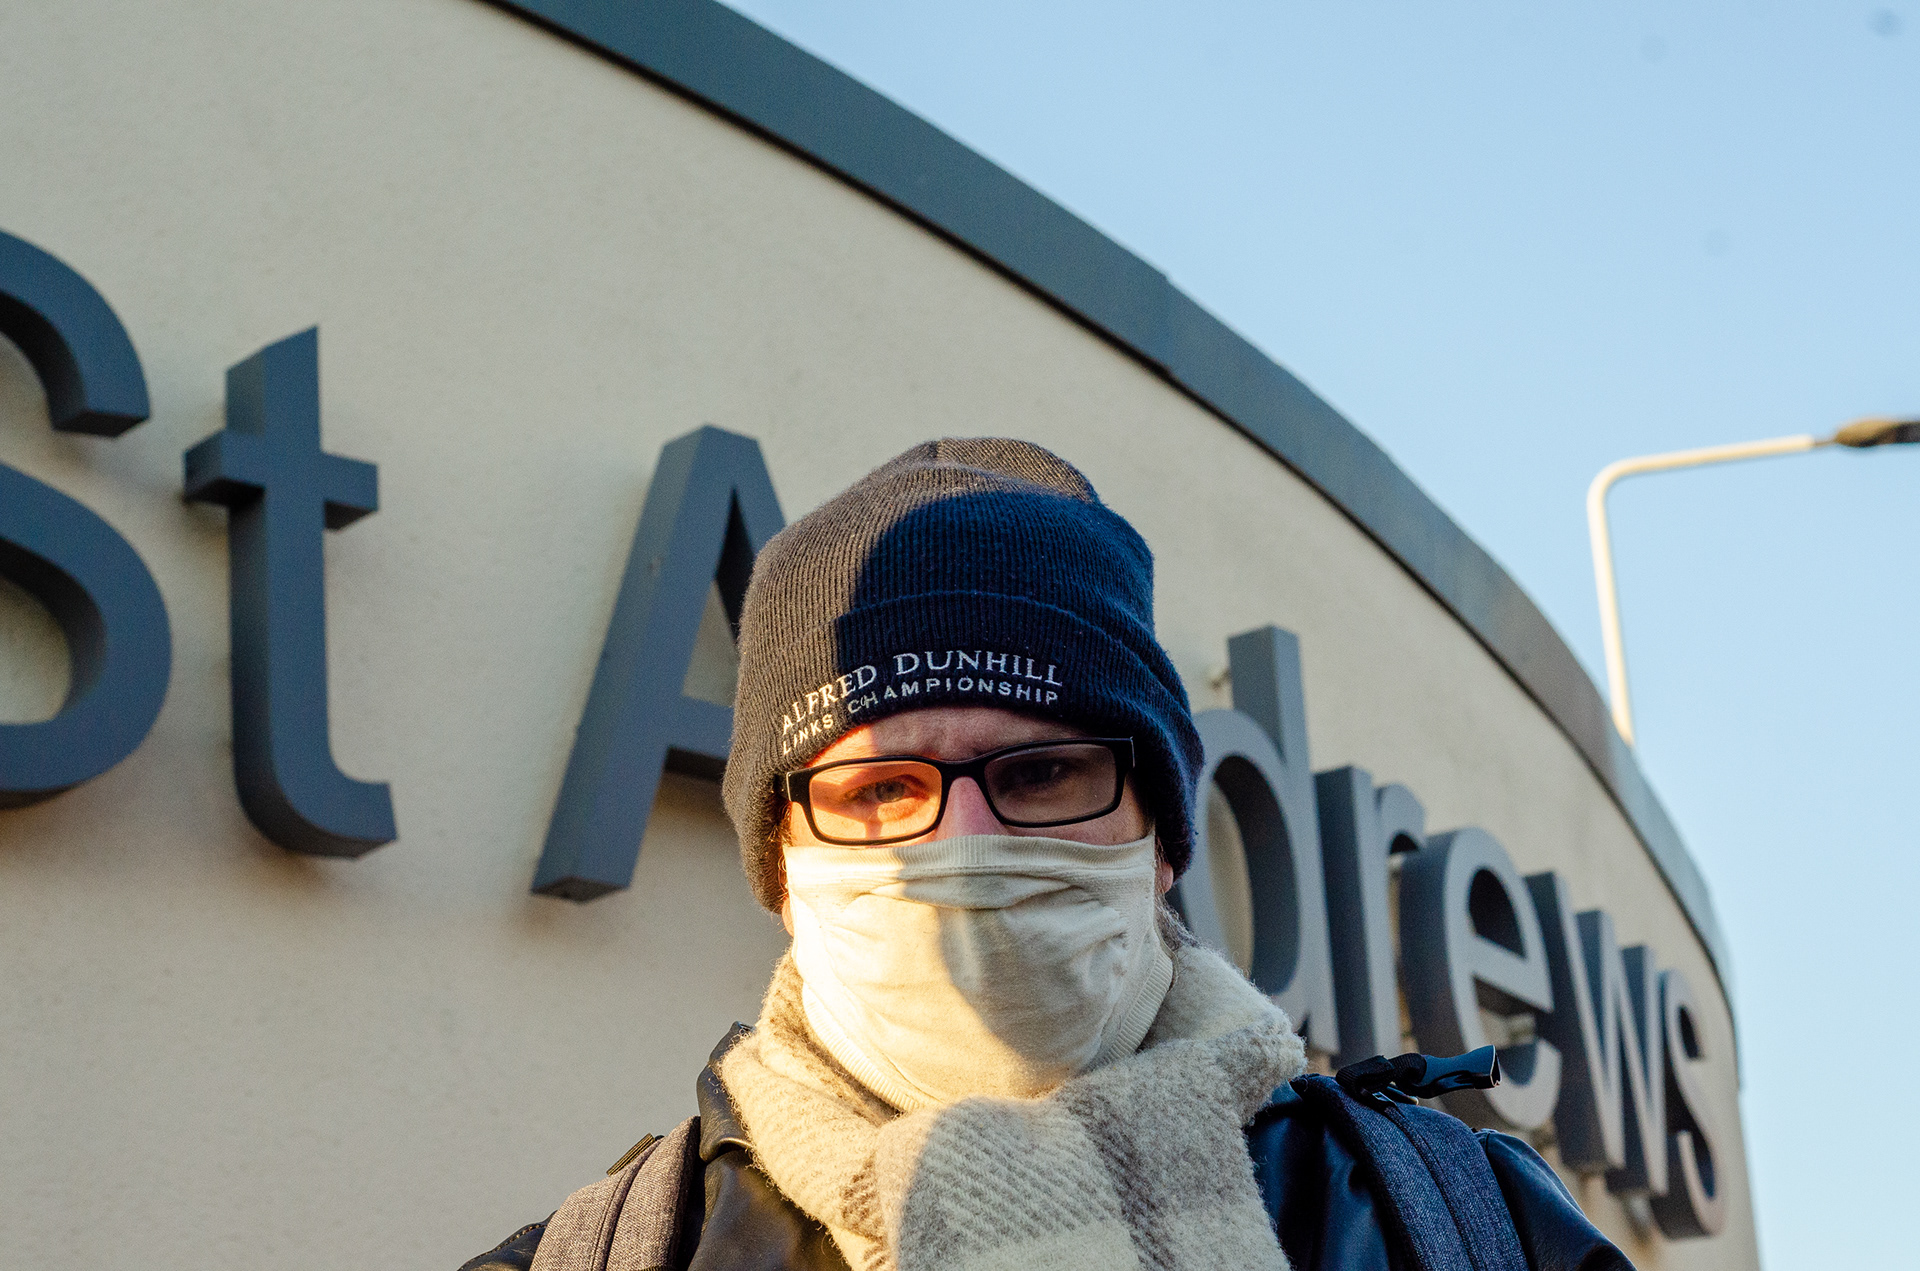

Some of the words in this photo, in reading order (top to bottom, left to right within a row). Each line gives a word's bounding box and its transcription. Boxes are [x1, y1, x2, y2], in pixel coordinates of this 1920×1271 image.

[782, 664, 878, 736] ALFRED
[893, 649, 1063, 688] DUNHILL
[782, 713, 834, 756] LINKS
[847, 675, 1059, 714] CHAMPIONSHIP
